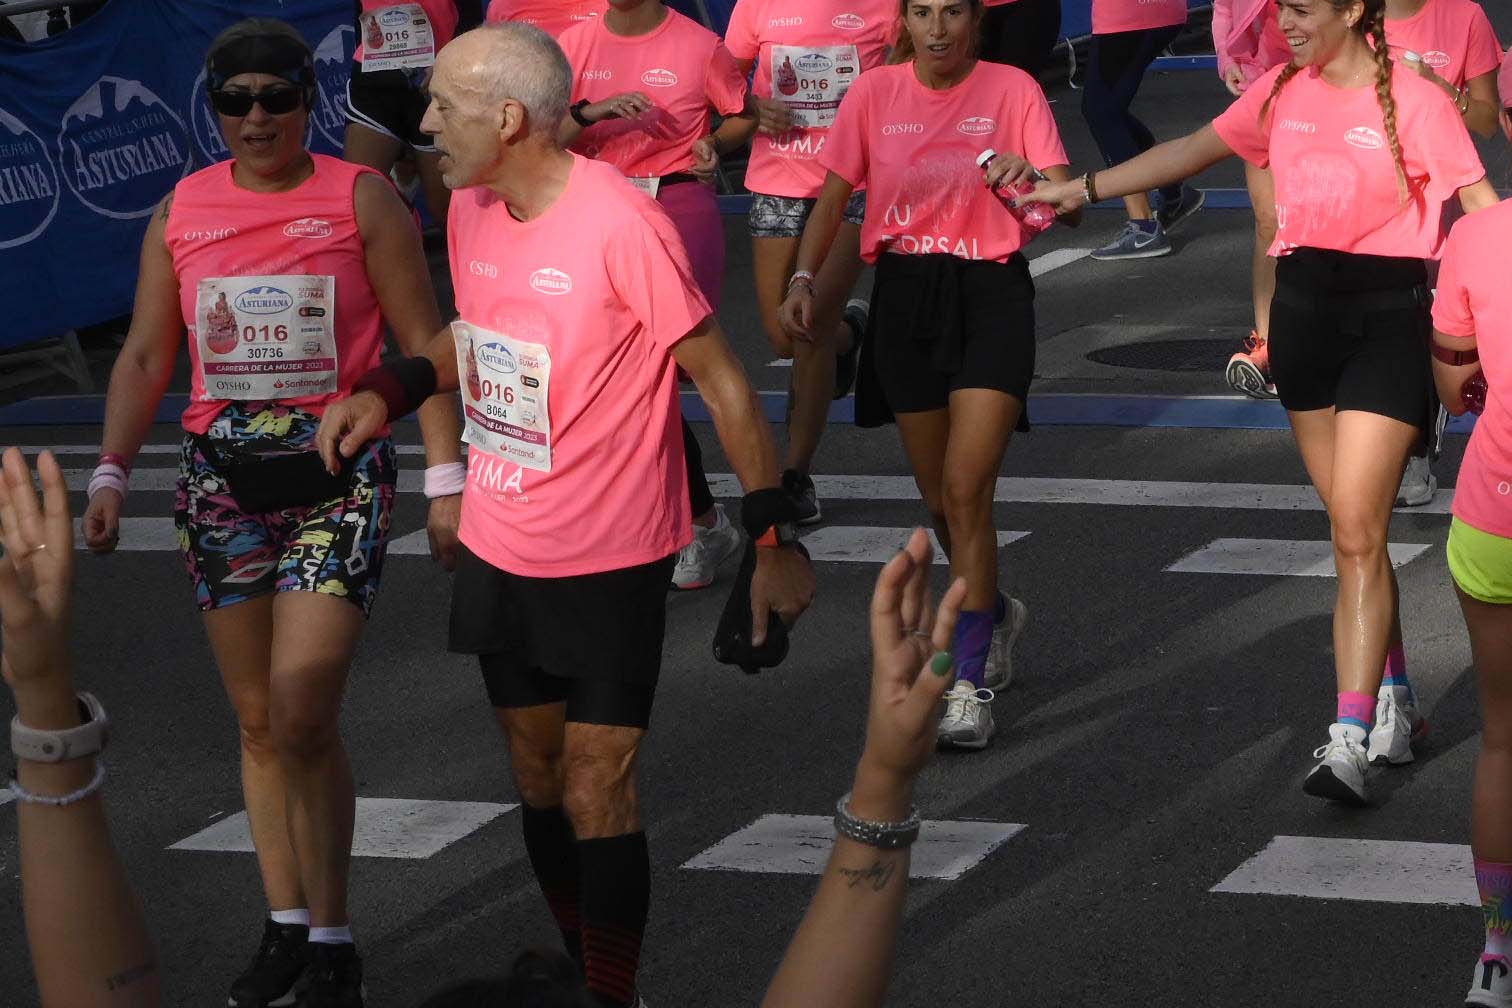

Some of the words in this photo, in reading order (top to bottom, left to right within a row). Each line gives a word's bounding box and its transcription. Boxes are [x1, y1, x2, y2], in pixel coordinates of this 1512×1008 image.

[385, 29, 410, 42] 016
[800, 78, 829, 91] 016
[881, 122, 924, 136] OYSHO
[70, 130, 185, 192] ASTURIANA
[239, 297, 290, 309] ASTURIANA
[242, 324, 289, 343] 016
[247, 347, 284, 359] 30736
[479, 348, 516, 371] ASTURIANA
[215, 364, 251, 373] CARRERA
[250, 364, 262, 372] DE
[263, 363, 275, 372] LA
[275, 362, 303, 371] MUJER
[216, 380, 251, 392] OYSHO
[284, 378, 328, 389] Santander
[481, 379, 515, 405] 016
[486, 404, 508, 419] 8064
[494, 422, 504, 434] LA
[503, 424, 523, 440] MUJER
